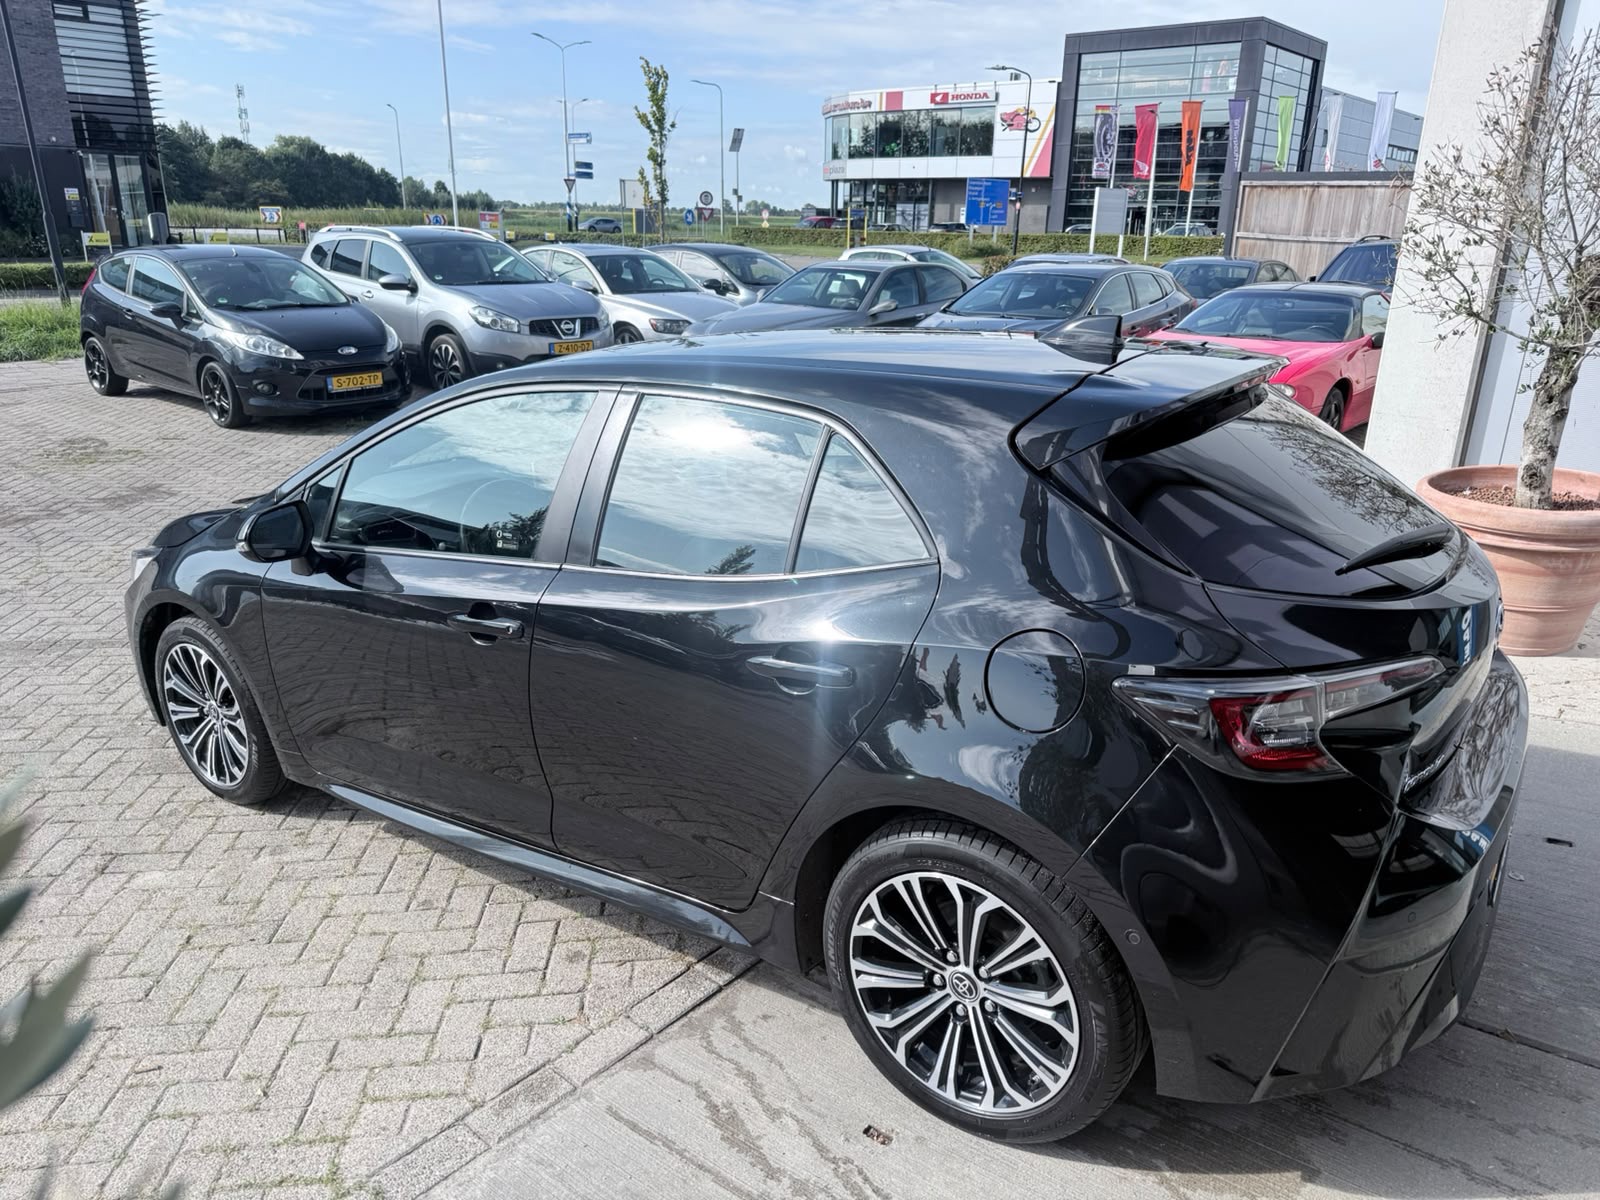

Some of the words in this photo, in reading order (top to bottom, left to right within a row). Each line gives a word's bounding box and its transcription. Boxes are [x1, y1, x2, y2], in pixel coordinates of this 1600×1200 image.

[950, 91, 990, 102] HONDA
[558, 343, 591, 354] Z-410-DZ
[336, 374, 379, 388] S-702-TP
